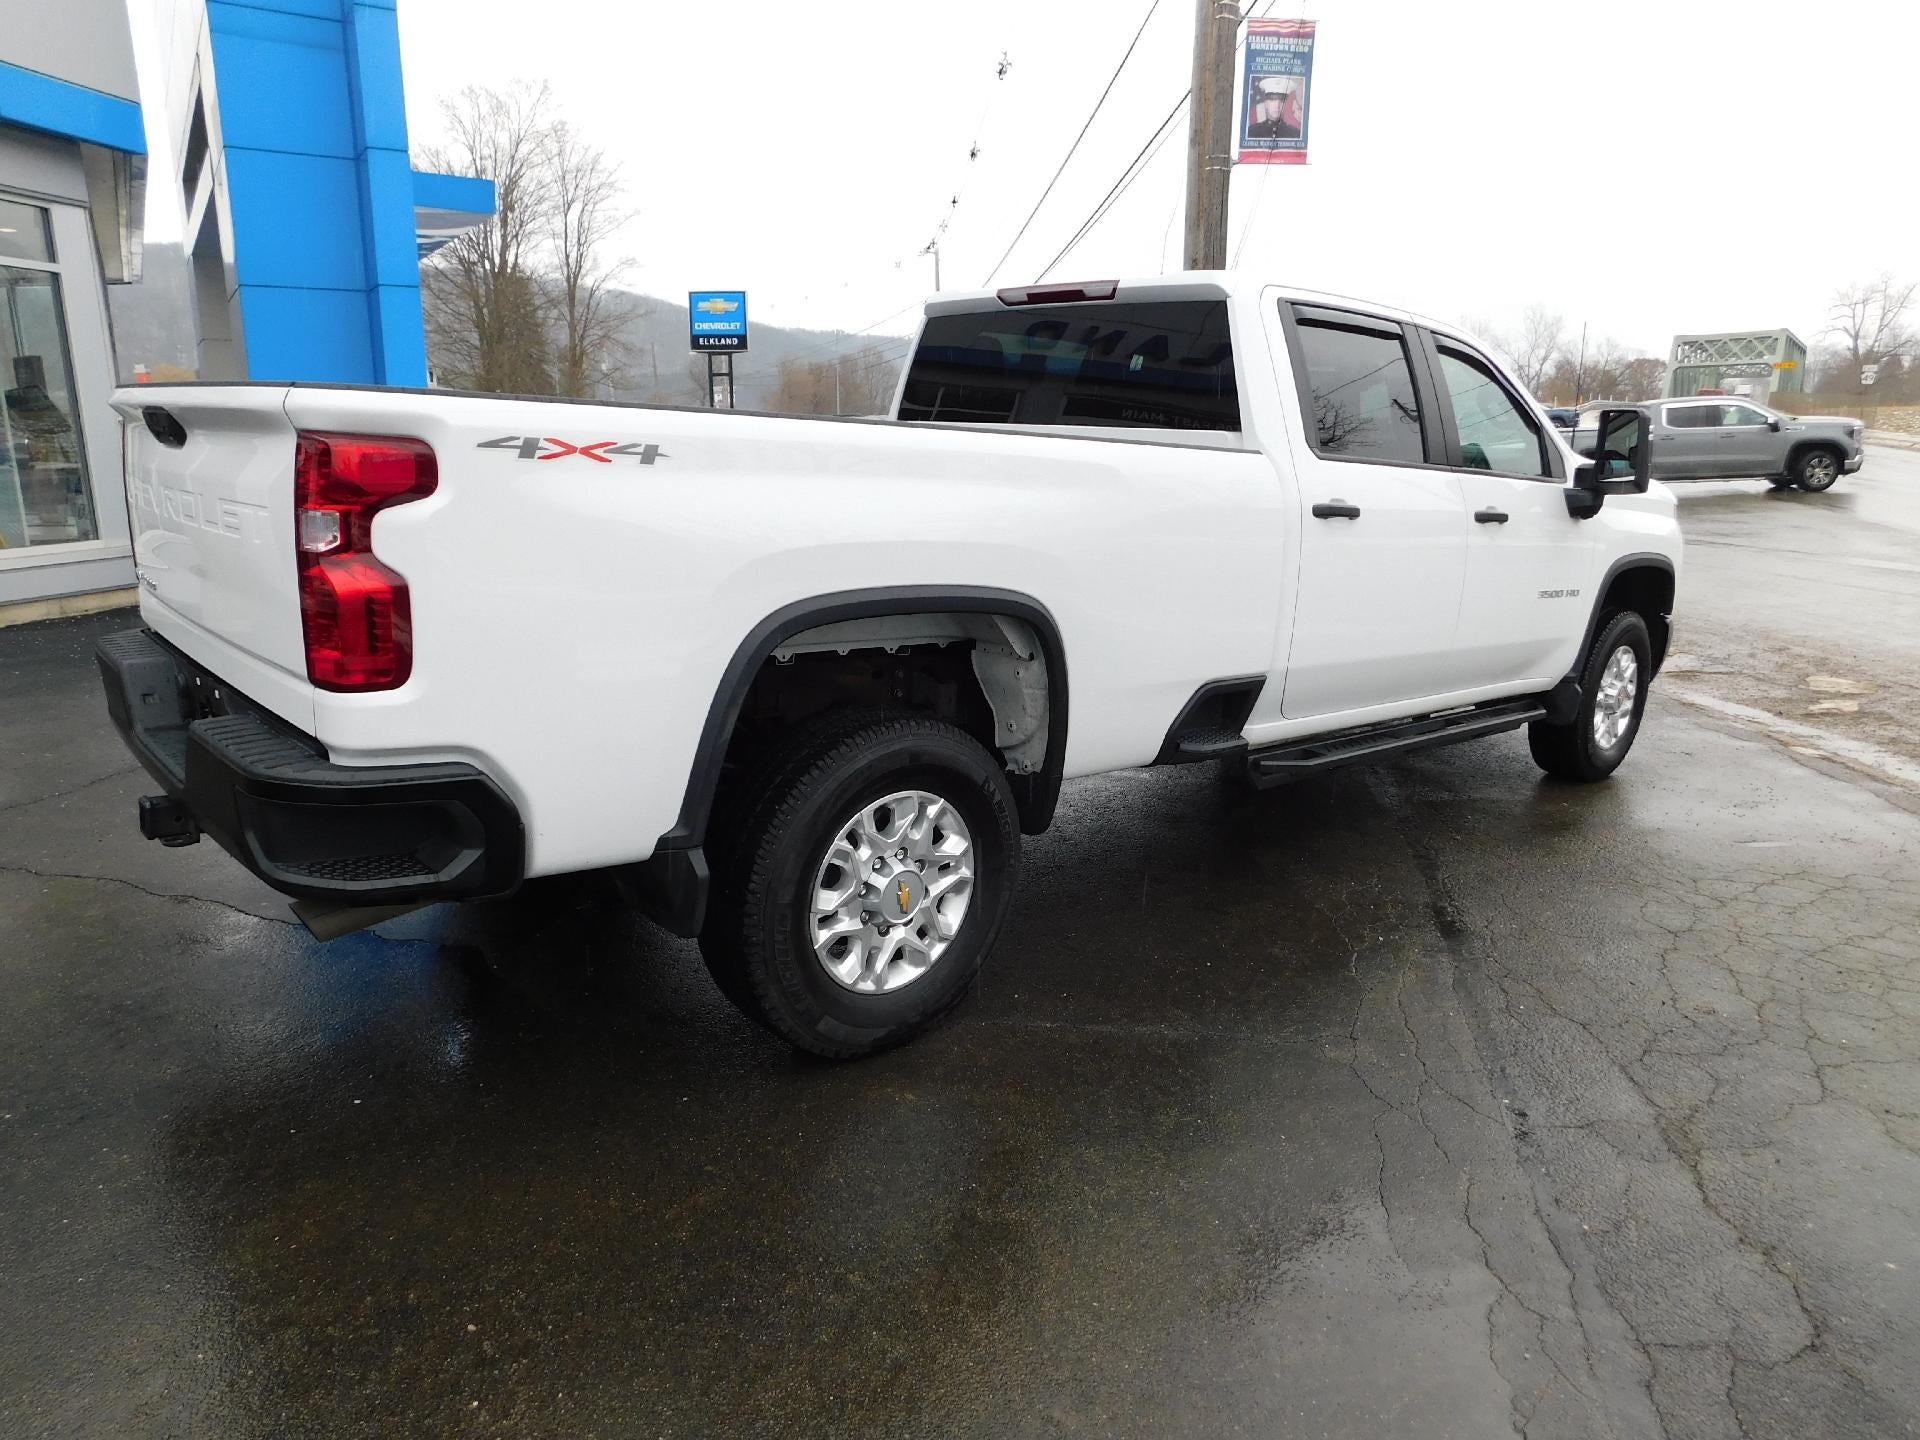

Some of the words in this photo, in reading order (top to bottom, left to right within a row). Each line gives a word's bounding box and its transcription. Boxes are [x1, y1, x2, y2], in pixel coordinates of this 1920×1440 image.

[1250, 43, 1289, 51] HOMETOWN
[1290, 45, 1309, 53] HERO
[694, 322, 741, 330] CHEVROLET
[699, 337, 738, 345] ELKLAND
[1537, 589, 1564, 599] 3500
[1565, 589, 1580, 598] HD
